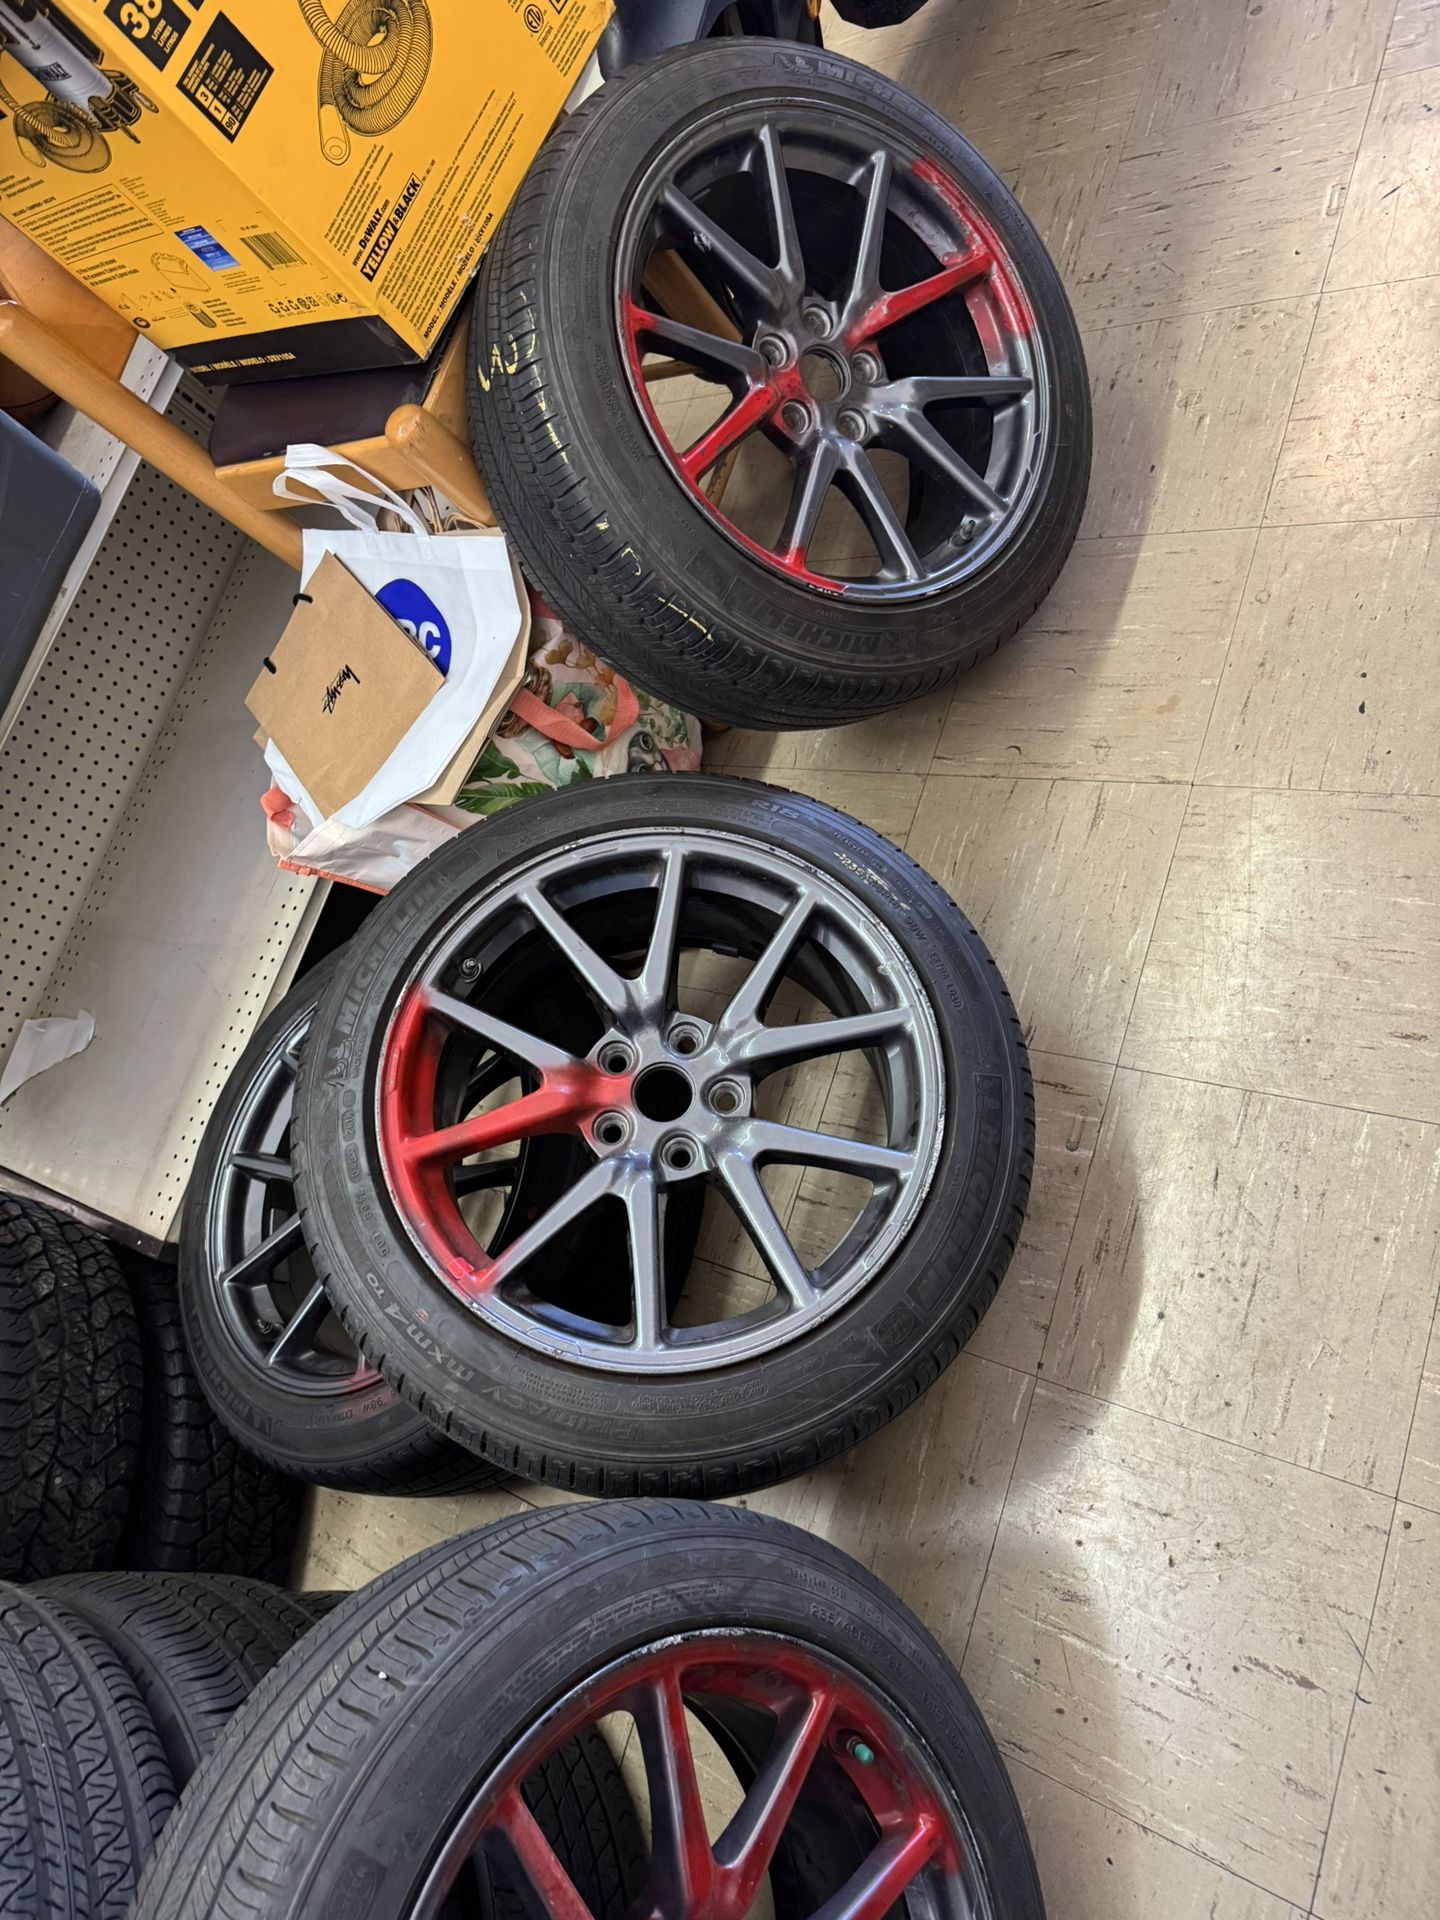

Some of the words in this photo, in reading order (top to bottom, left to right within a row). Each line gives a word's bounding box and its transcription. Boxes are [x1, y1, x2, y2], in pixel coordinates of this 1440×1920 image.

[200, 91, 209, 101] 3
[225, 118, 236, 130] 90
[362, 221, 396, 277] YELLOW
[395, 178, 420, 219] BLACK
[424, 314, 439, 339] MODEL
[457, 246, 475, 276] MODELO
[735, 588, 884, 655] MICHELIN
[750, 799, 799, 820] R18
[337, 871, 448, 1036] MICHELIN
[916, 1120, 1003, 1313] MICHELIN
[365, 1271, 387, 1300] TO
[362, 1397, 384, 1413] 98W
